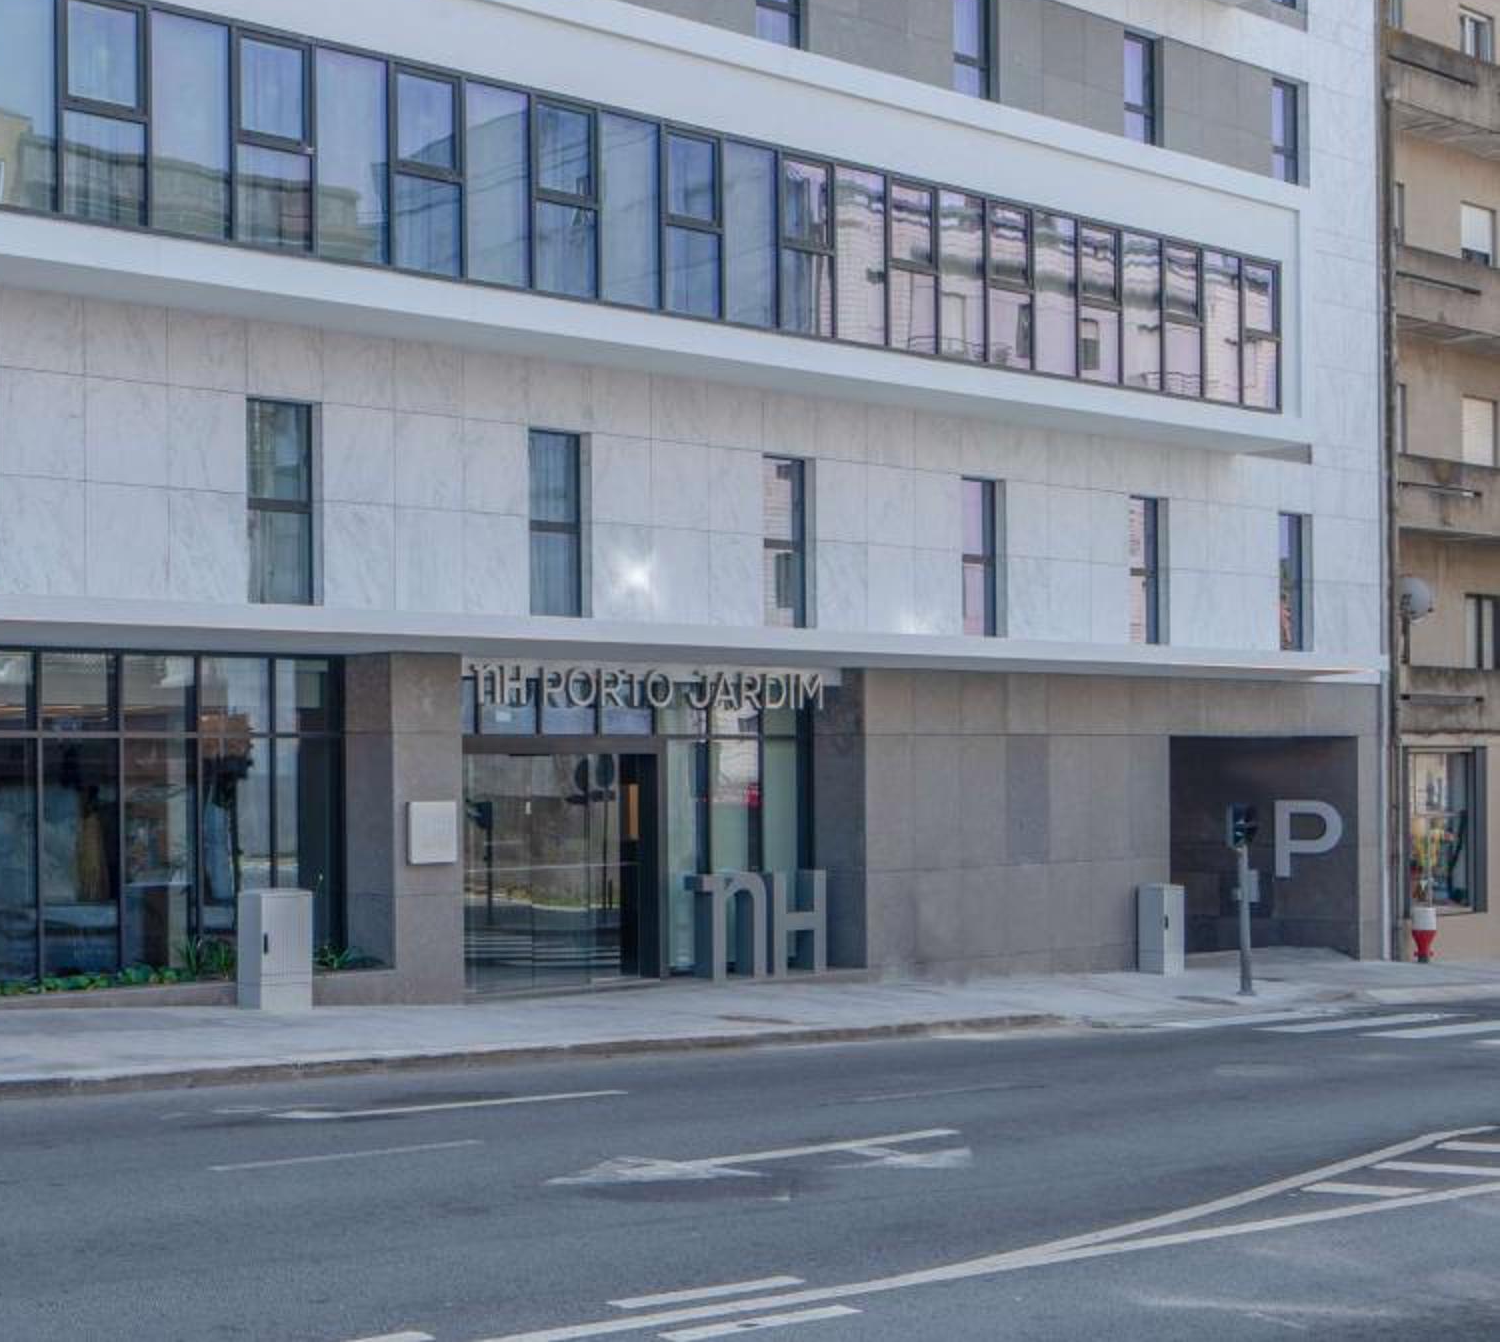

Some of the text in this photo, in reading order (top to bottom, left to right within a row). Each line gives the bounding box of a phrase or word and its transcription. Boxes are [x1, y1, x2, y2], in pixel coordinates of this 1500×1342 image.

[542, 668, 674, 708] PORTO
[687, 671, 825, 710] JARDIM
[1274, 799, 1344, 879] P
